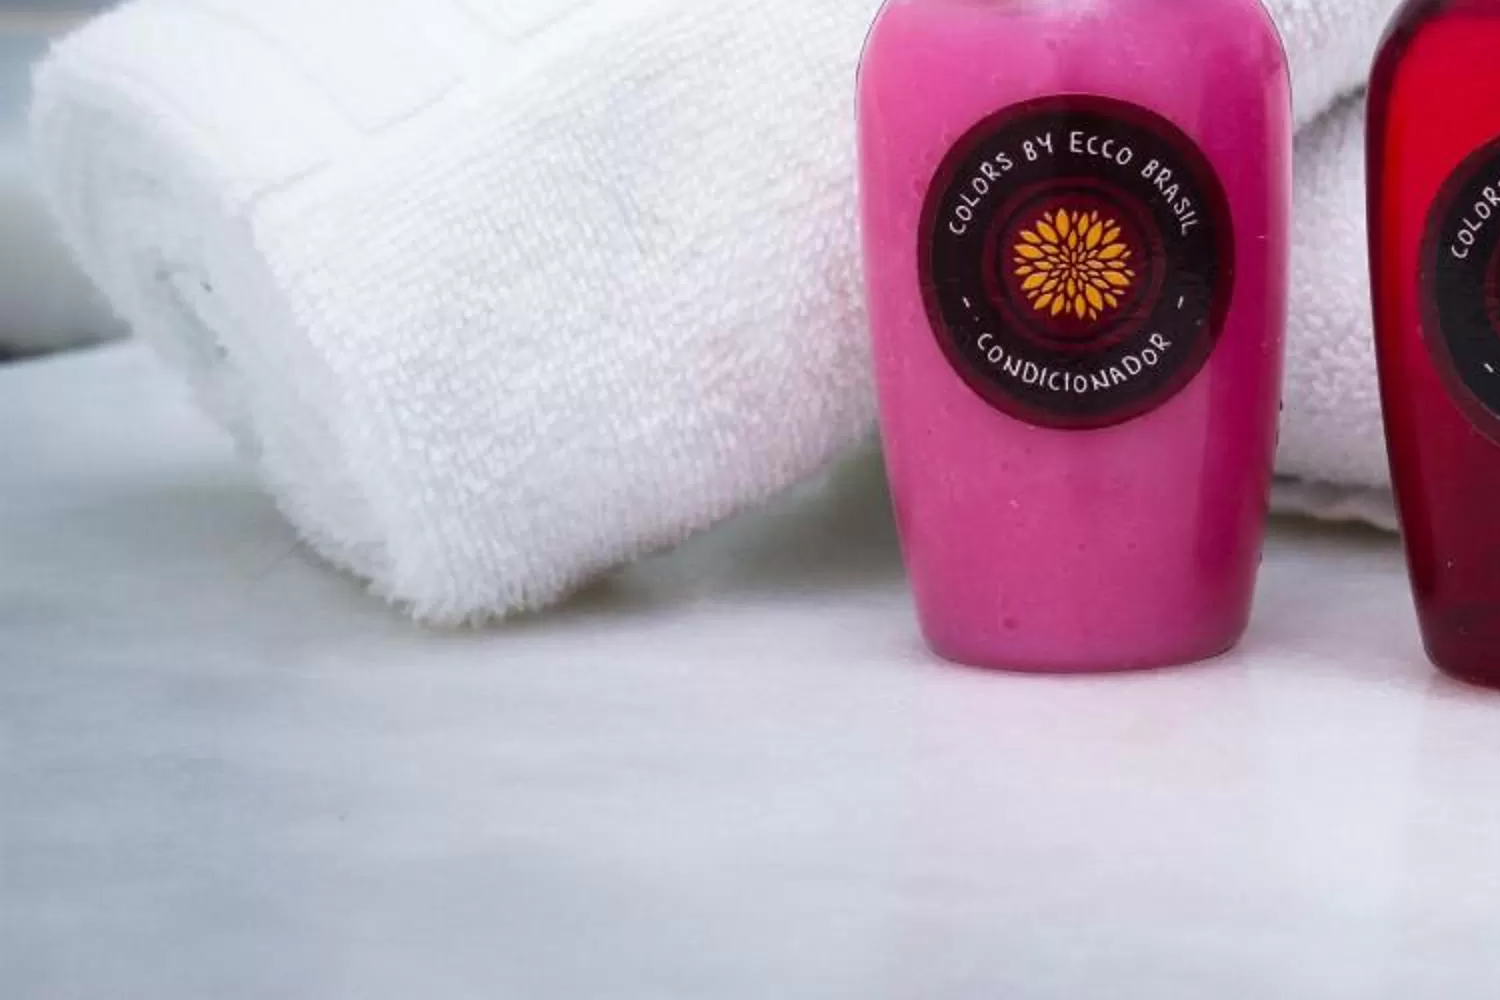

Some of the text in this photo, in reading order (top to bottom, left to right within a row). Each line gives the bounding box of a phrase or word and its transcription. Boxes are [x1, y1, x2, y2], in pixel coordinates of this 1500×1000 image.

[950, 131, 1199, 236] COLORS BY ECCO BRASIL
[977, 332, 1172, 393] CONDICIONADOR
